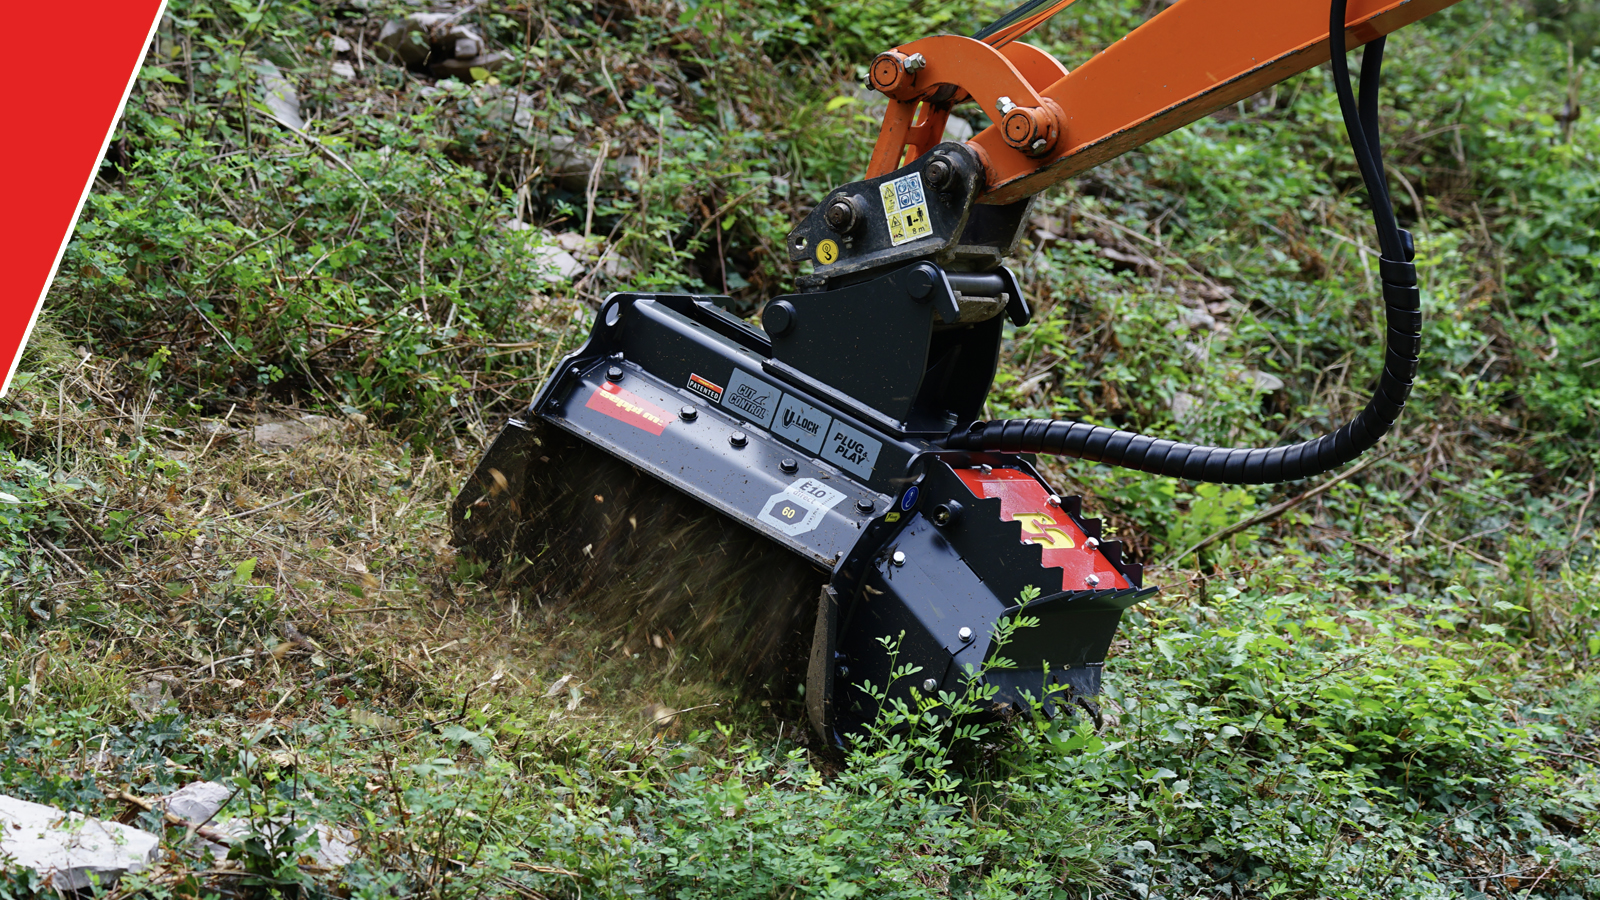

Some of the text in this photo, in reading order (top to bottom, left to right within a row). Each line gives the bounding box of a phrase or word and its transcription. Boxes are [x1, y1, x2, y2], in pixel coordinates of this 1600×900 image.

[690, 380, 719, 399] PATENTED
[736, 383, 757, 400] CUT
[599, 389, 644, 415] seppi
[728, 392, 766, 419] CONTROL
[834, 444, 865, 466] PLAY
[799, 481, 827, 498] E10
[781, 506, 796, 519] 60
